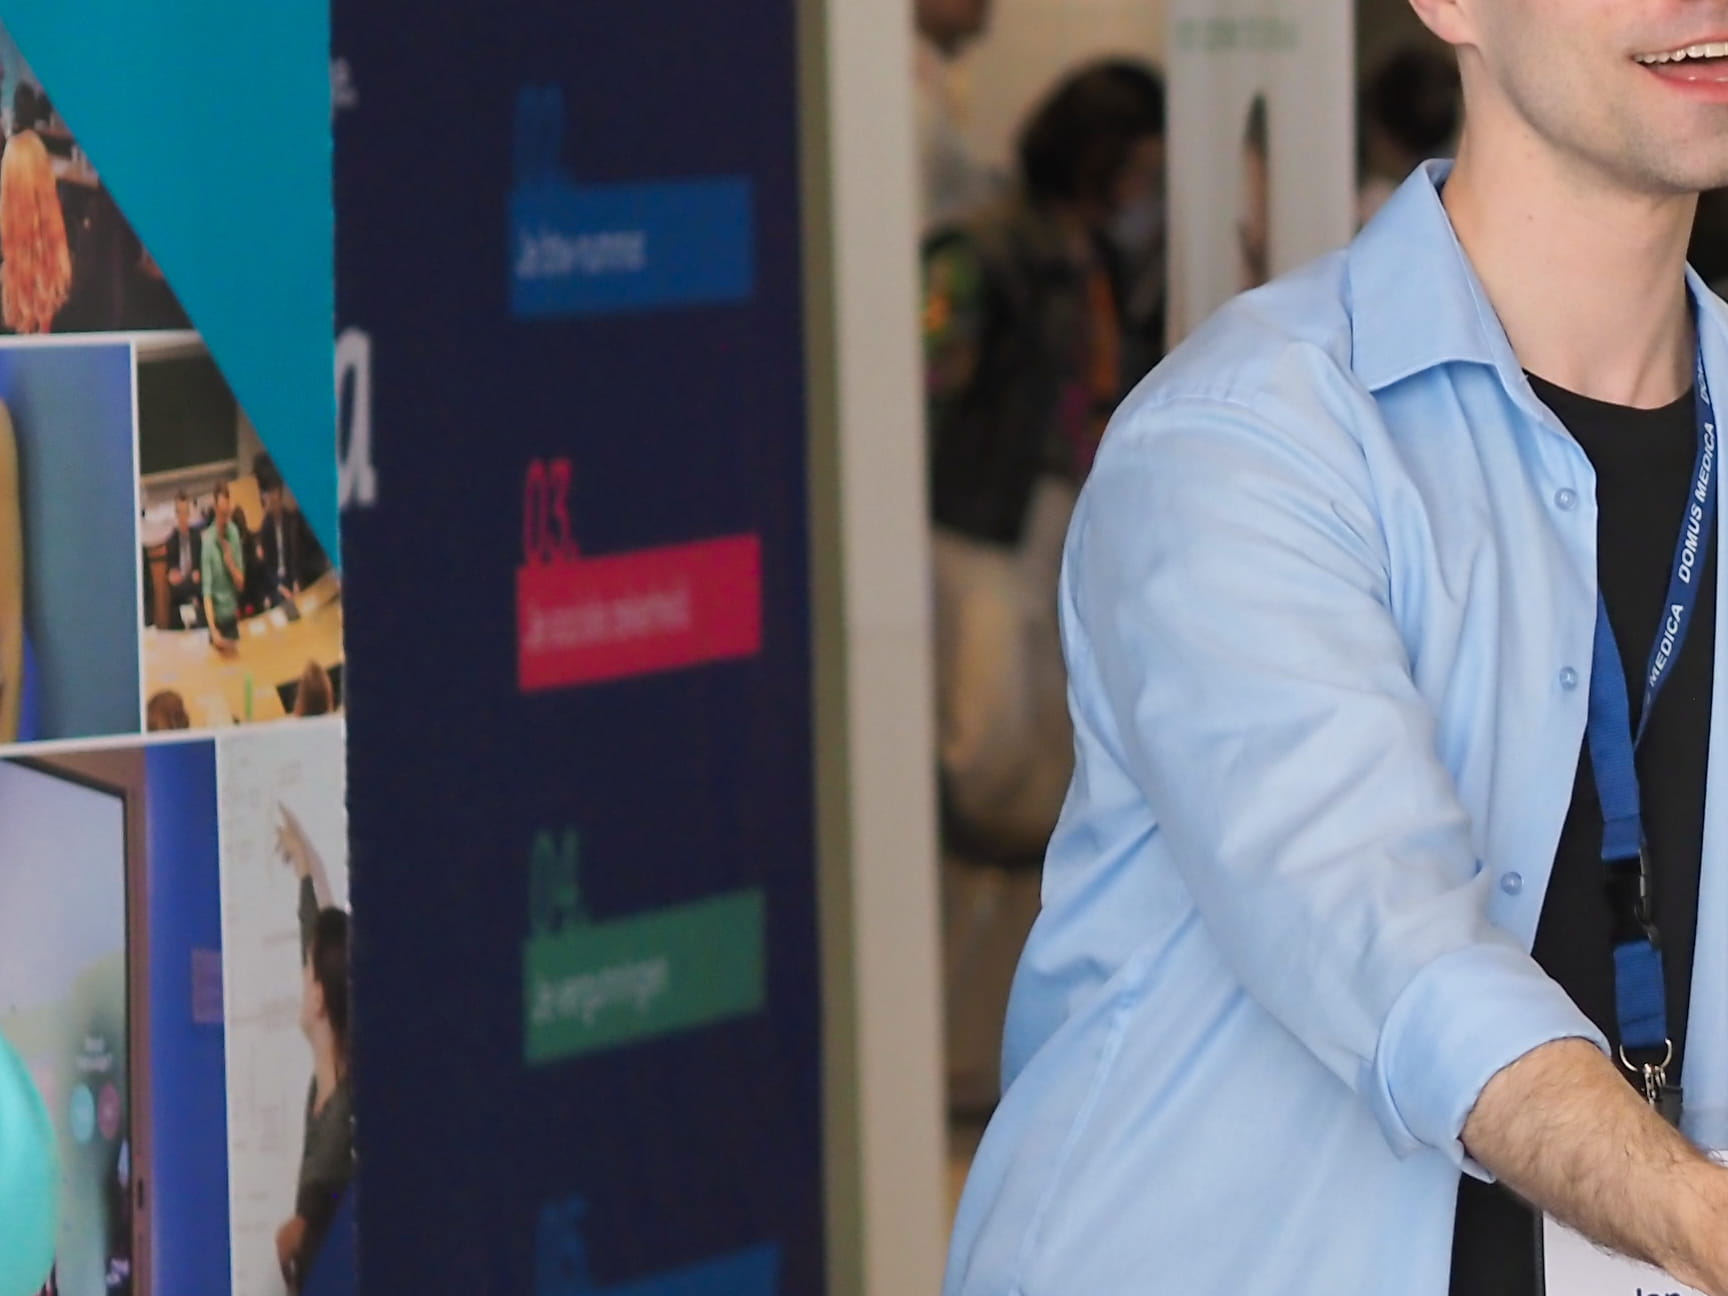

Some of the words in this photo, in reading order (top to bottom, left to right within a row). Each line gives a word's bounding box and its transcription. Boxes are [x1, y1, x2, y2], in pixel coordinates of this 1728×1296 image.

[1677, 503, 1703, 585] DOMUS
[1694, 421, 1716, 503] MEDICA
[1648, 602, 1684, 687] MEDICA
